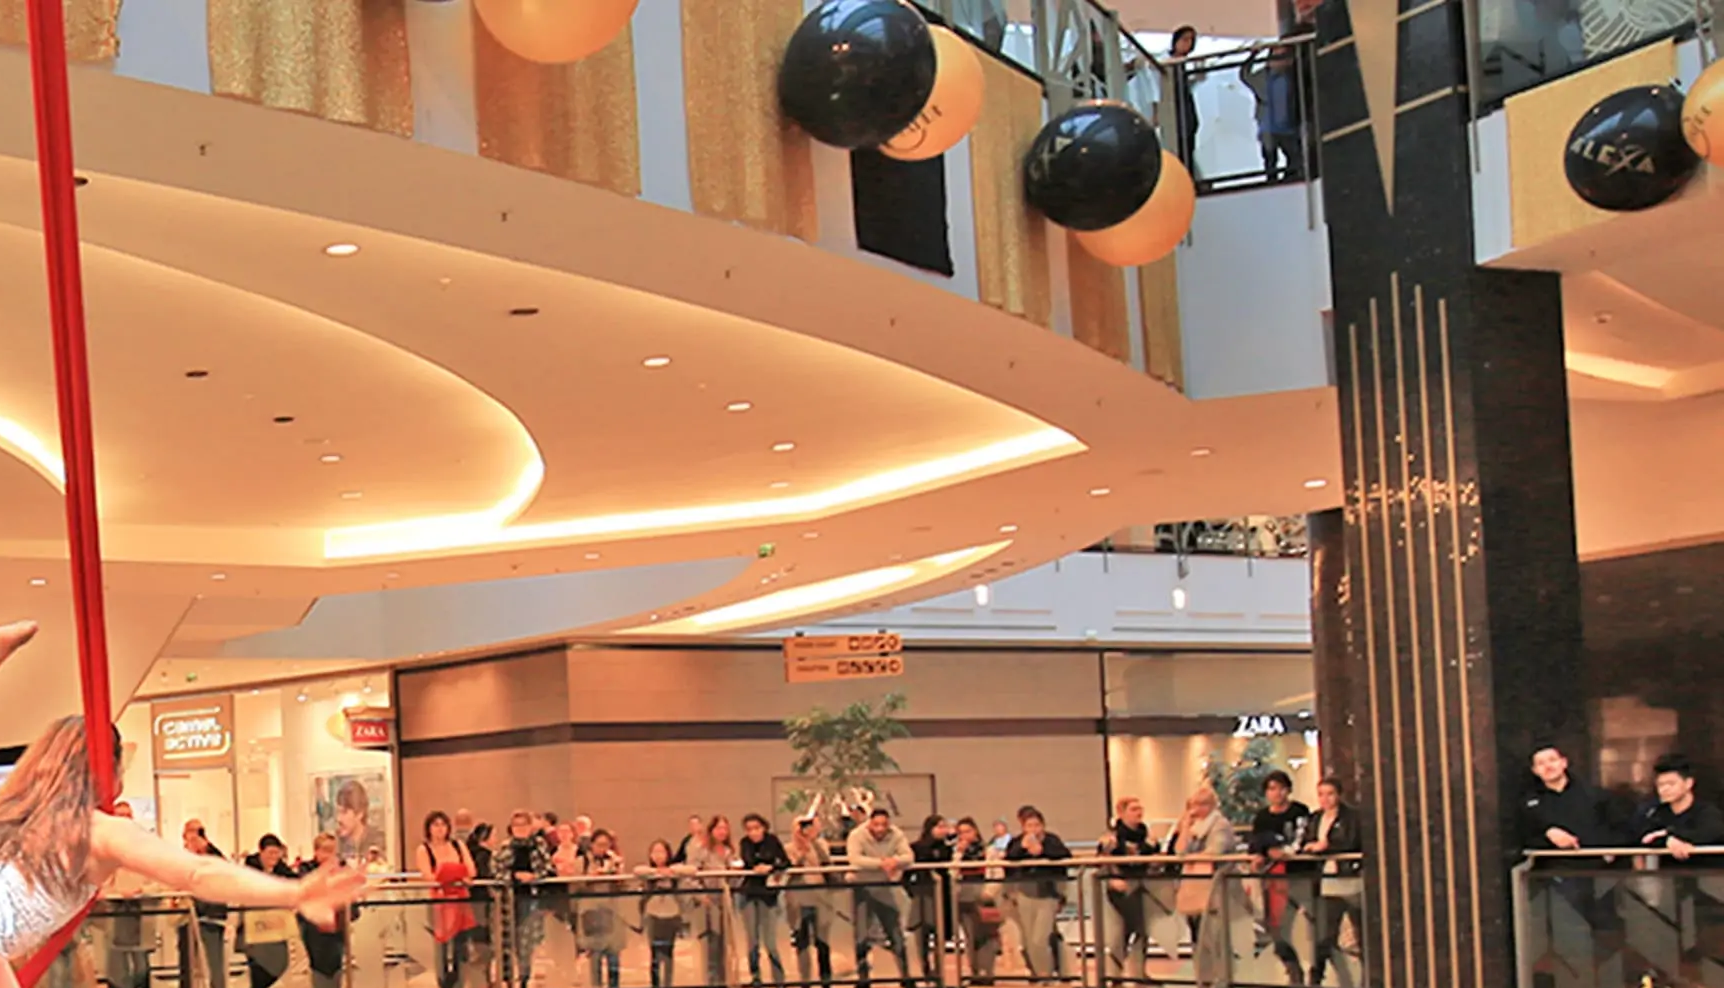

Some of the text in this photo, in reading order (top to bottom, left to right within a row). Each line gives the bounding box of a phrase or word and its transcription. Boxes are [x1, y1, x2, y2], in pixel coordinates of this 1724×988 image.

[1569, 135, 1655, 176] ALEXA
[355, 725, 387, 738] ZARA
[1232, 715, 1285, 738] ZARA
